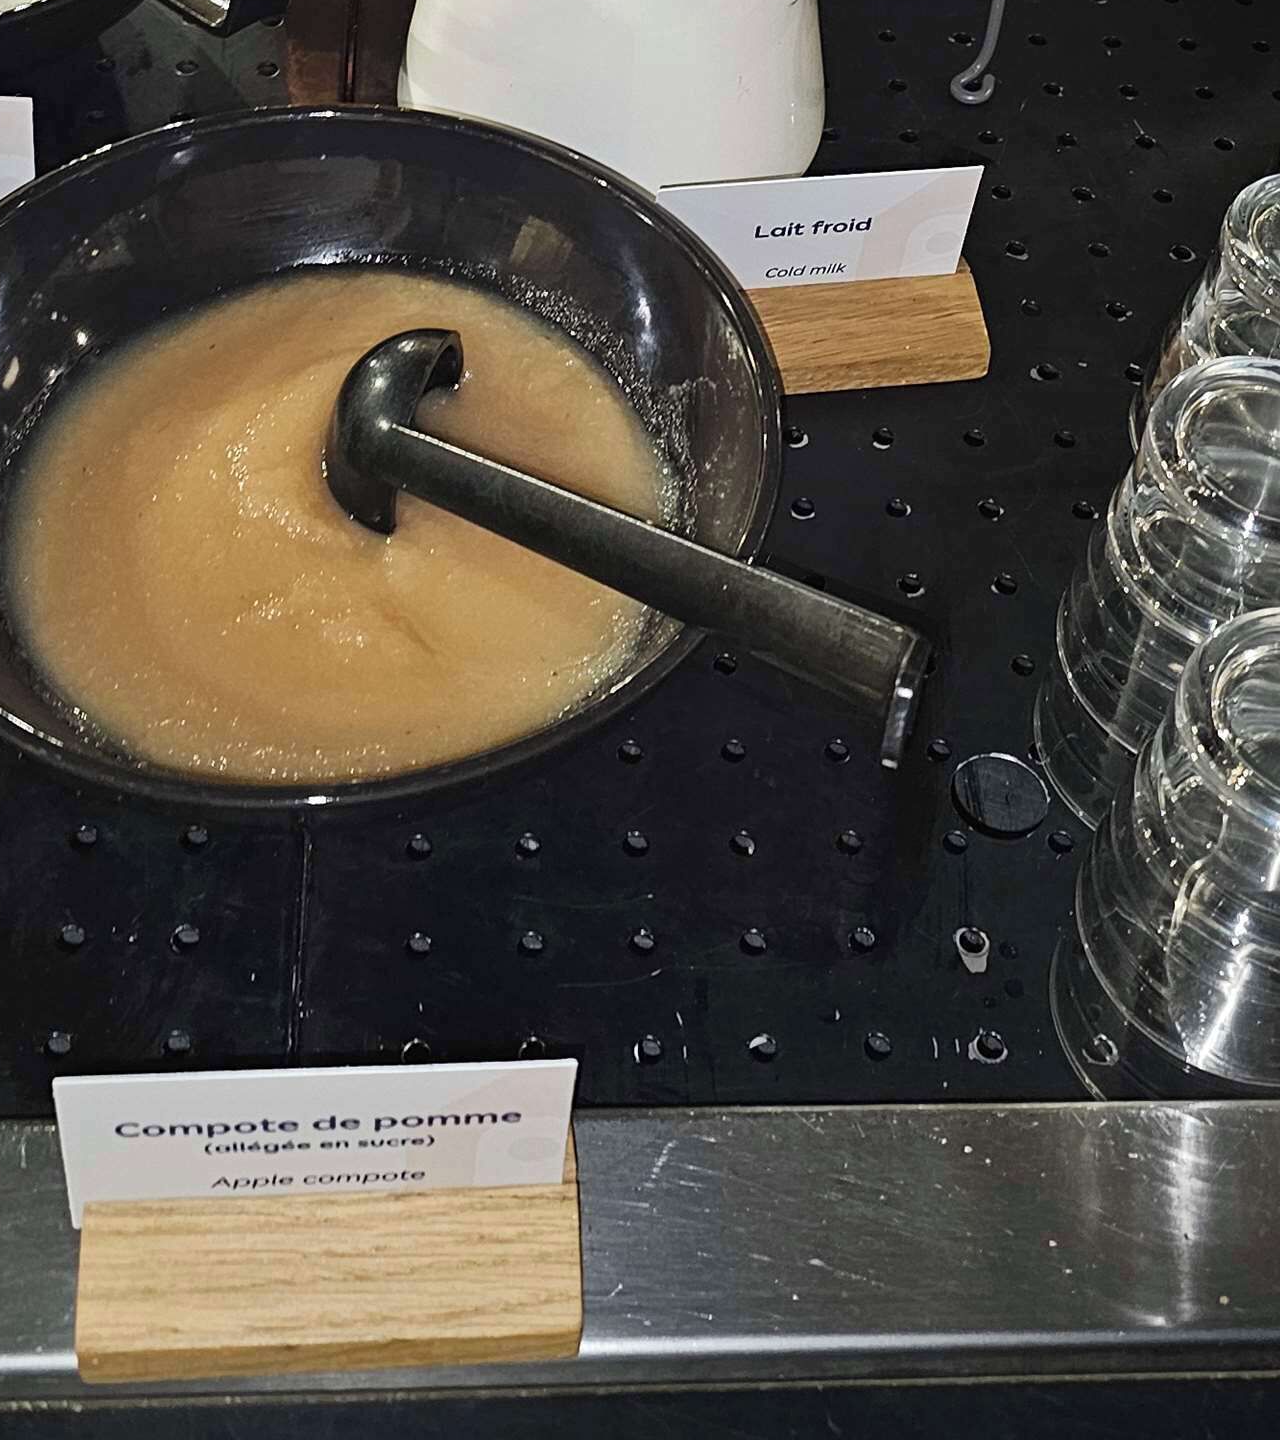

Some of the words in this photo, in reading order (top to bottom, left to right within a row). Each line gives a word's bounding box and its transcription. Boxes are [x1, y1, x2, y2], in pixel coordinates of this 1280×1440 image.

[753, 221, 805, 239] Lait
[811, 217, 873, 235] froid
[765, 264, 807, 279] Cold
[809, 262, 847, 277] milk
[113, 1118, 300, 1140] Compote
[312, 1114, 361, 1132] de
[373, 1108, 523, 1133] pomme
[203, 1138, 311, 1156] (allégée
[319, 1139, 350, 1150] en
[357, 1133, 436, 1150] sucre)
[210, 1172, 294, 1191] Apple
[303, 1168, 427, 1188] compote
